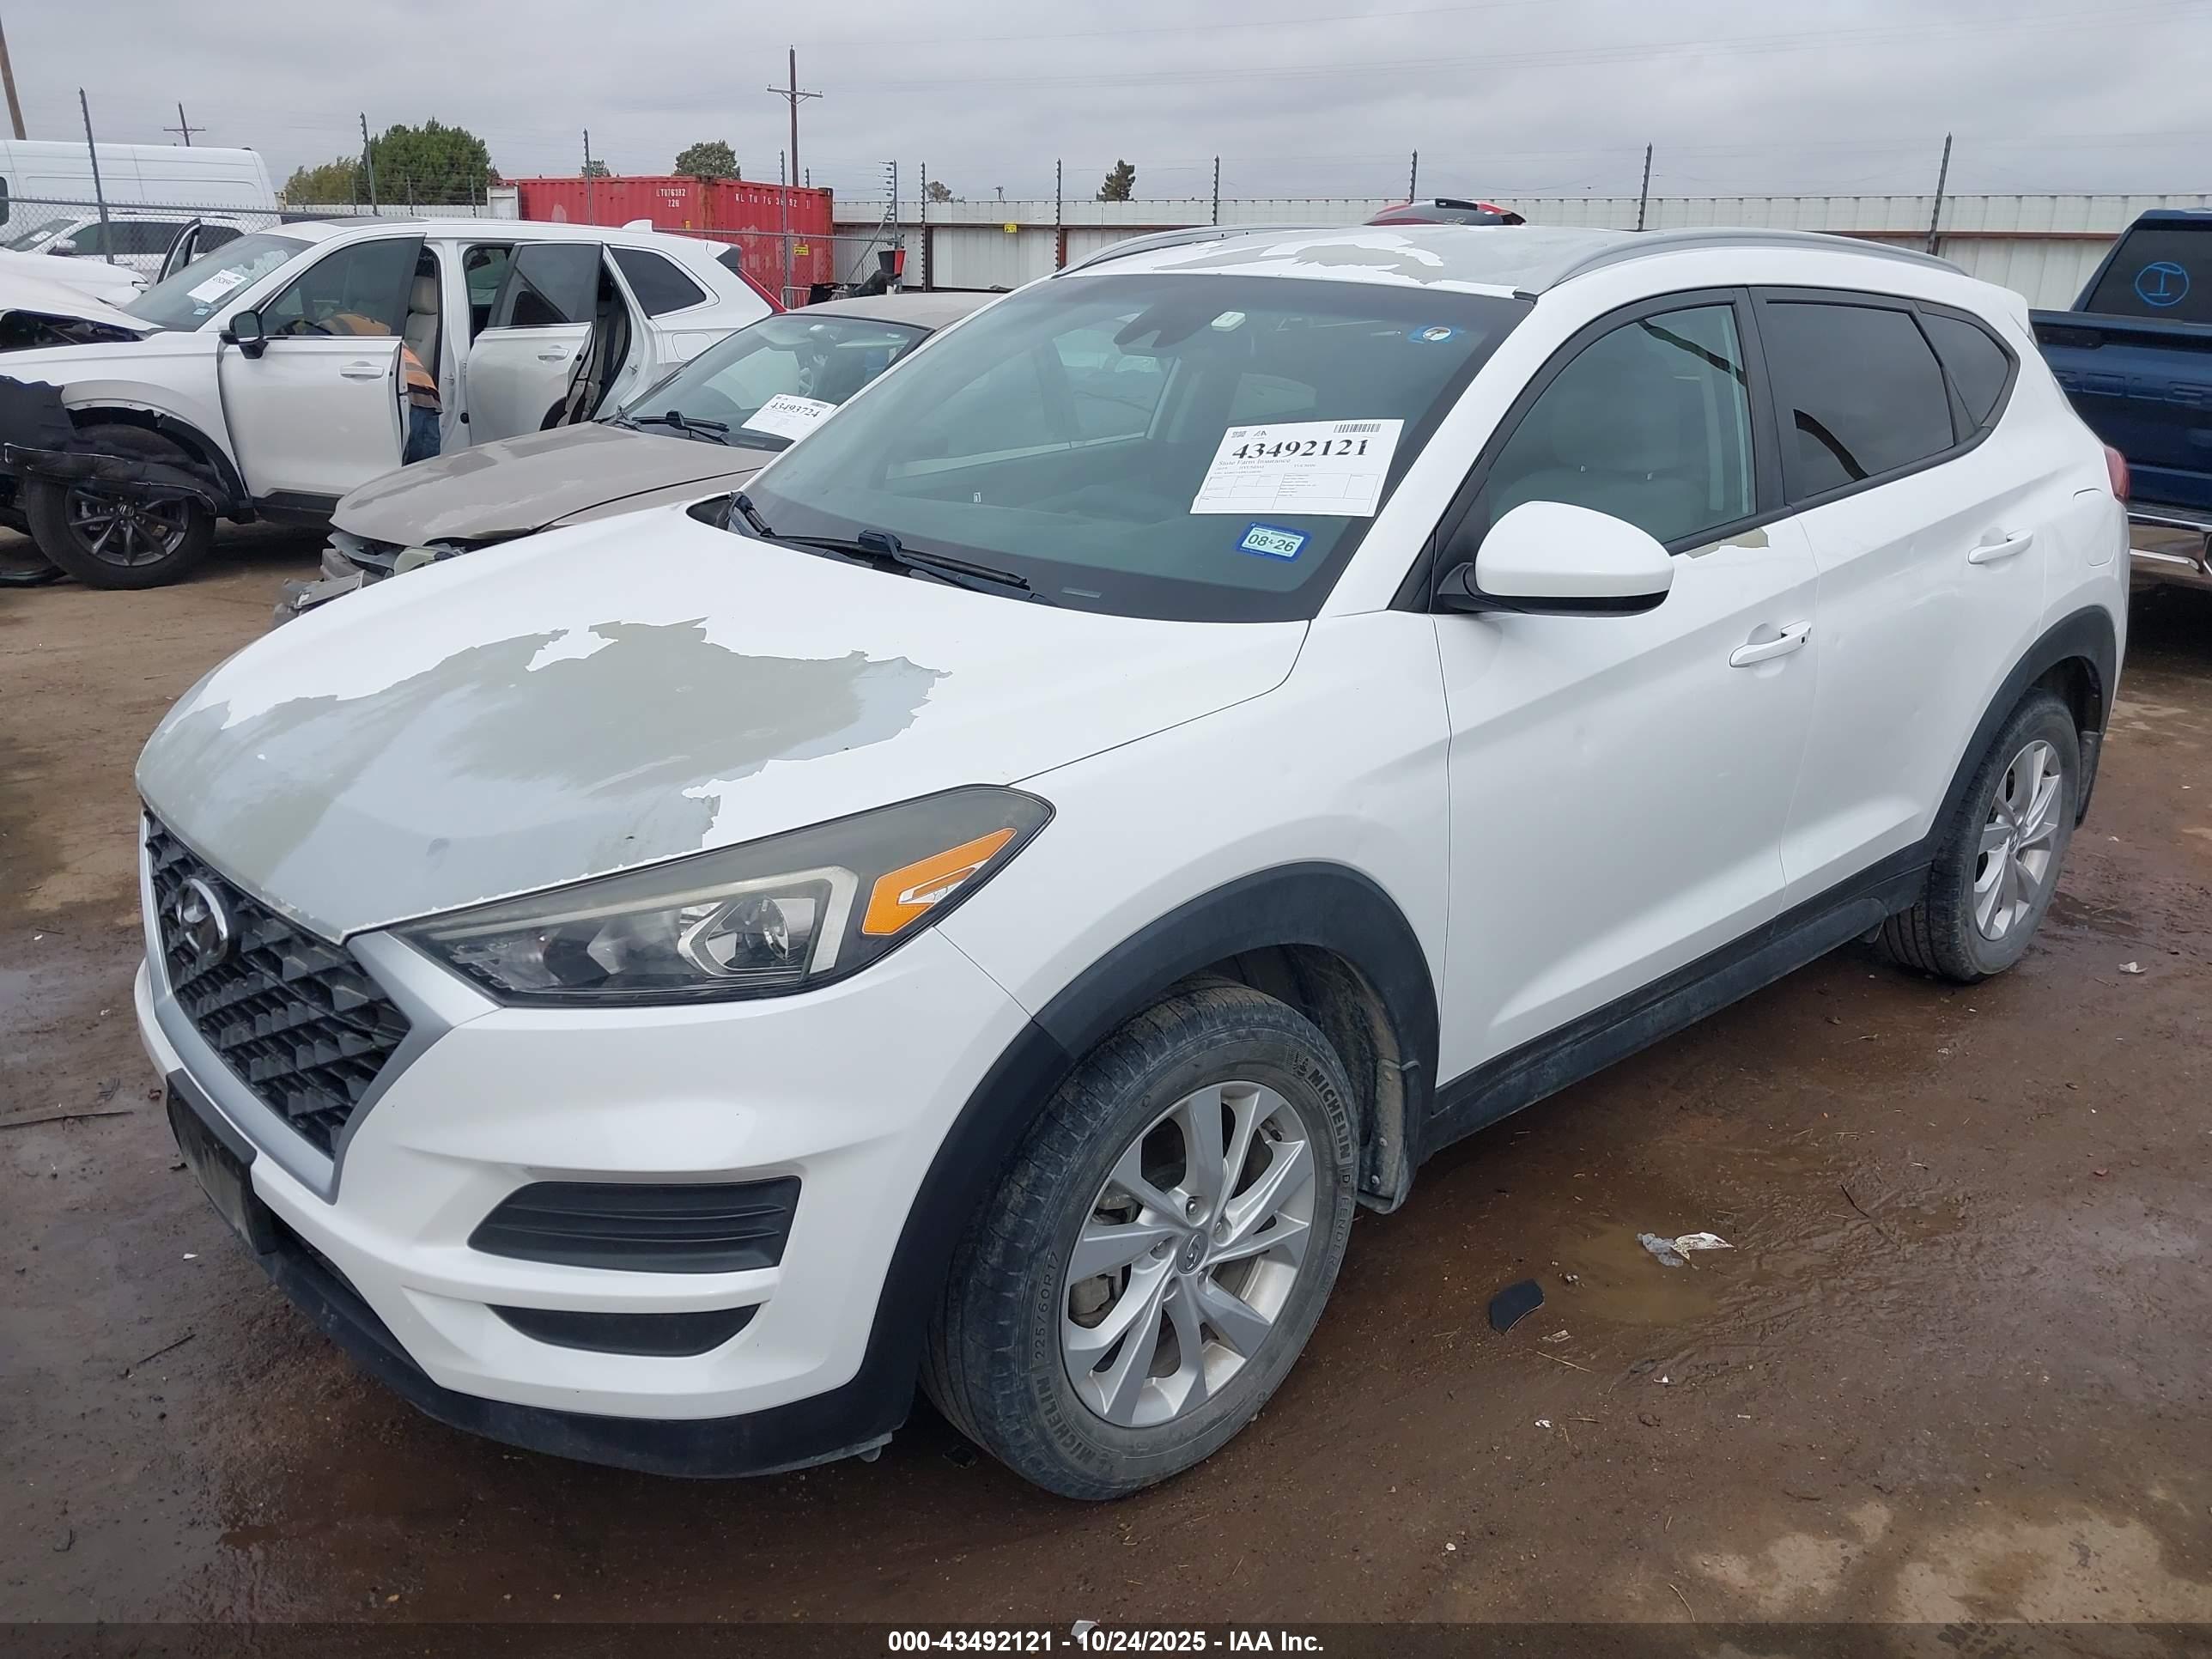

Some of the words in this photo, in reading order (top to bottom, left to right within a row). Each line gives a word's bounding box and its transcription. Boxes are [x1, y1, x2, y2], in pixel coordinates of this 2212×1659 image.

[1232, 439, 1369, 459] 43492121
[1248, 534, 1268, 546] 08
[1273, 539, 1296, 551] 26
[1308, 1068, 1352, 1159] MICHELIN
[1327, 1173, 1352, 1267] DEFENDER
[1035, 1251, 1059, 1360] 225/60R17
[1036, 1377, 1097, 1462] MICHELIN
